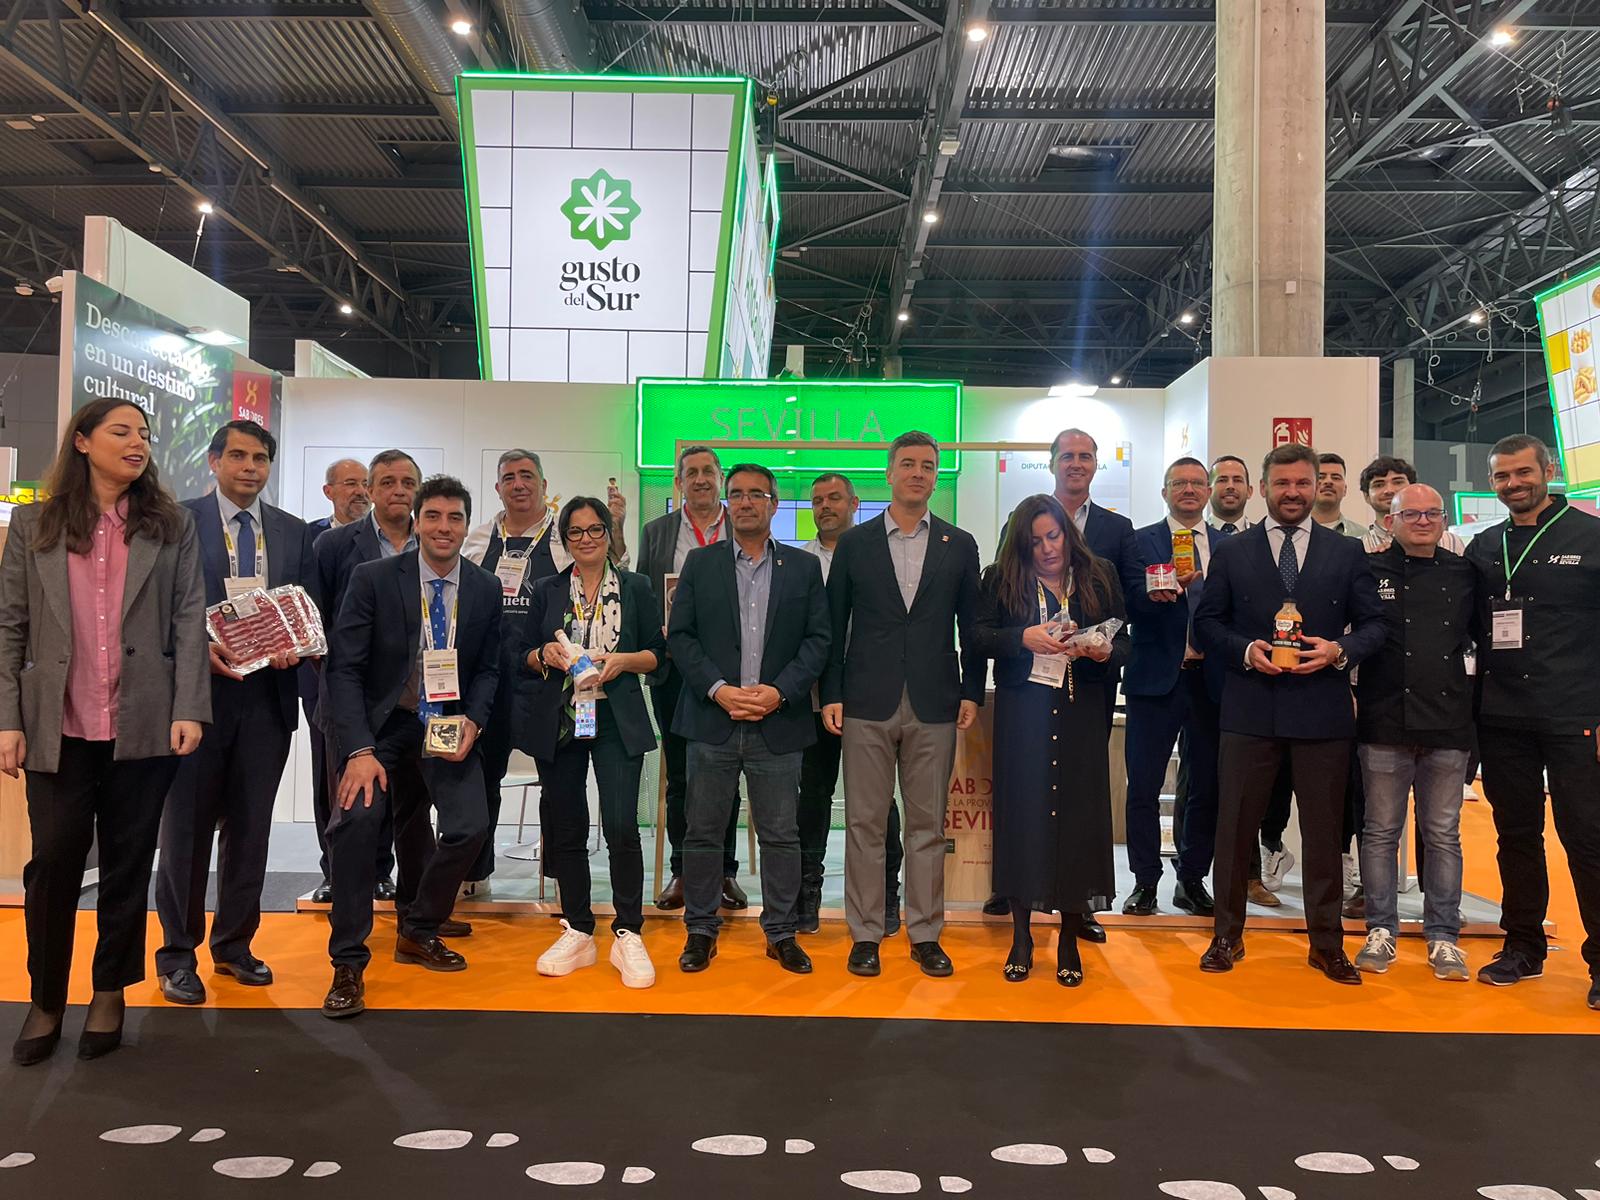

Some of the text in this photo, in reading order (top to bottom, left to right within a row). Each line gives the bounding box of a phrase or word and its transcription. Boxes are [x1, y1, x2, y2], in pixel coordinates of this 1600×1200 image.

[559, 256, 641, 291] gusto
[564, 282, 641, 311] del Sur
[84, 342, 196, 401] en un destino
[83, 375, 155, 416] cultural
[710, 407, 886, 442] SEVILLA
[1449, 444, 1474, 491] 1
[966, 799, 992, 807] PROV
